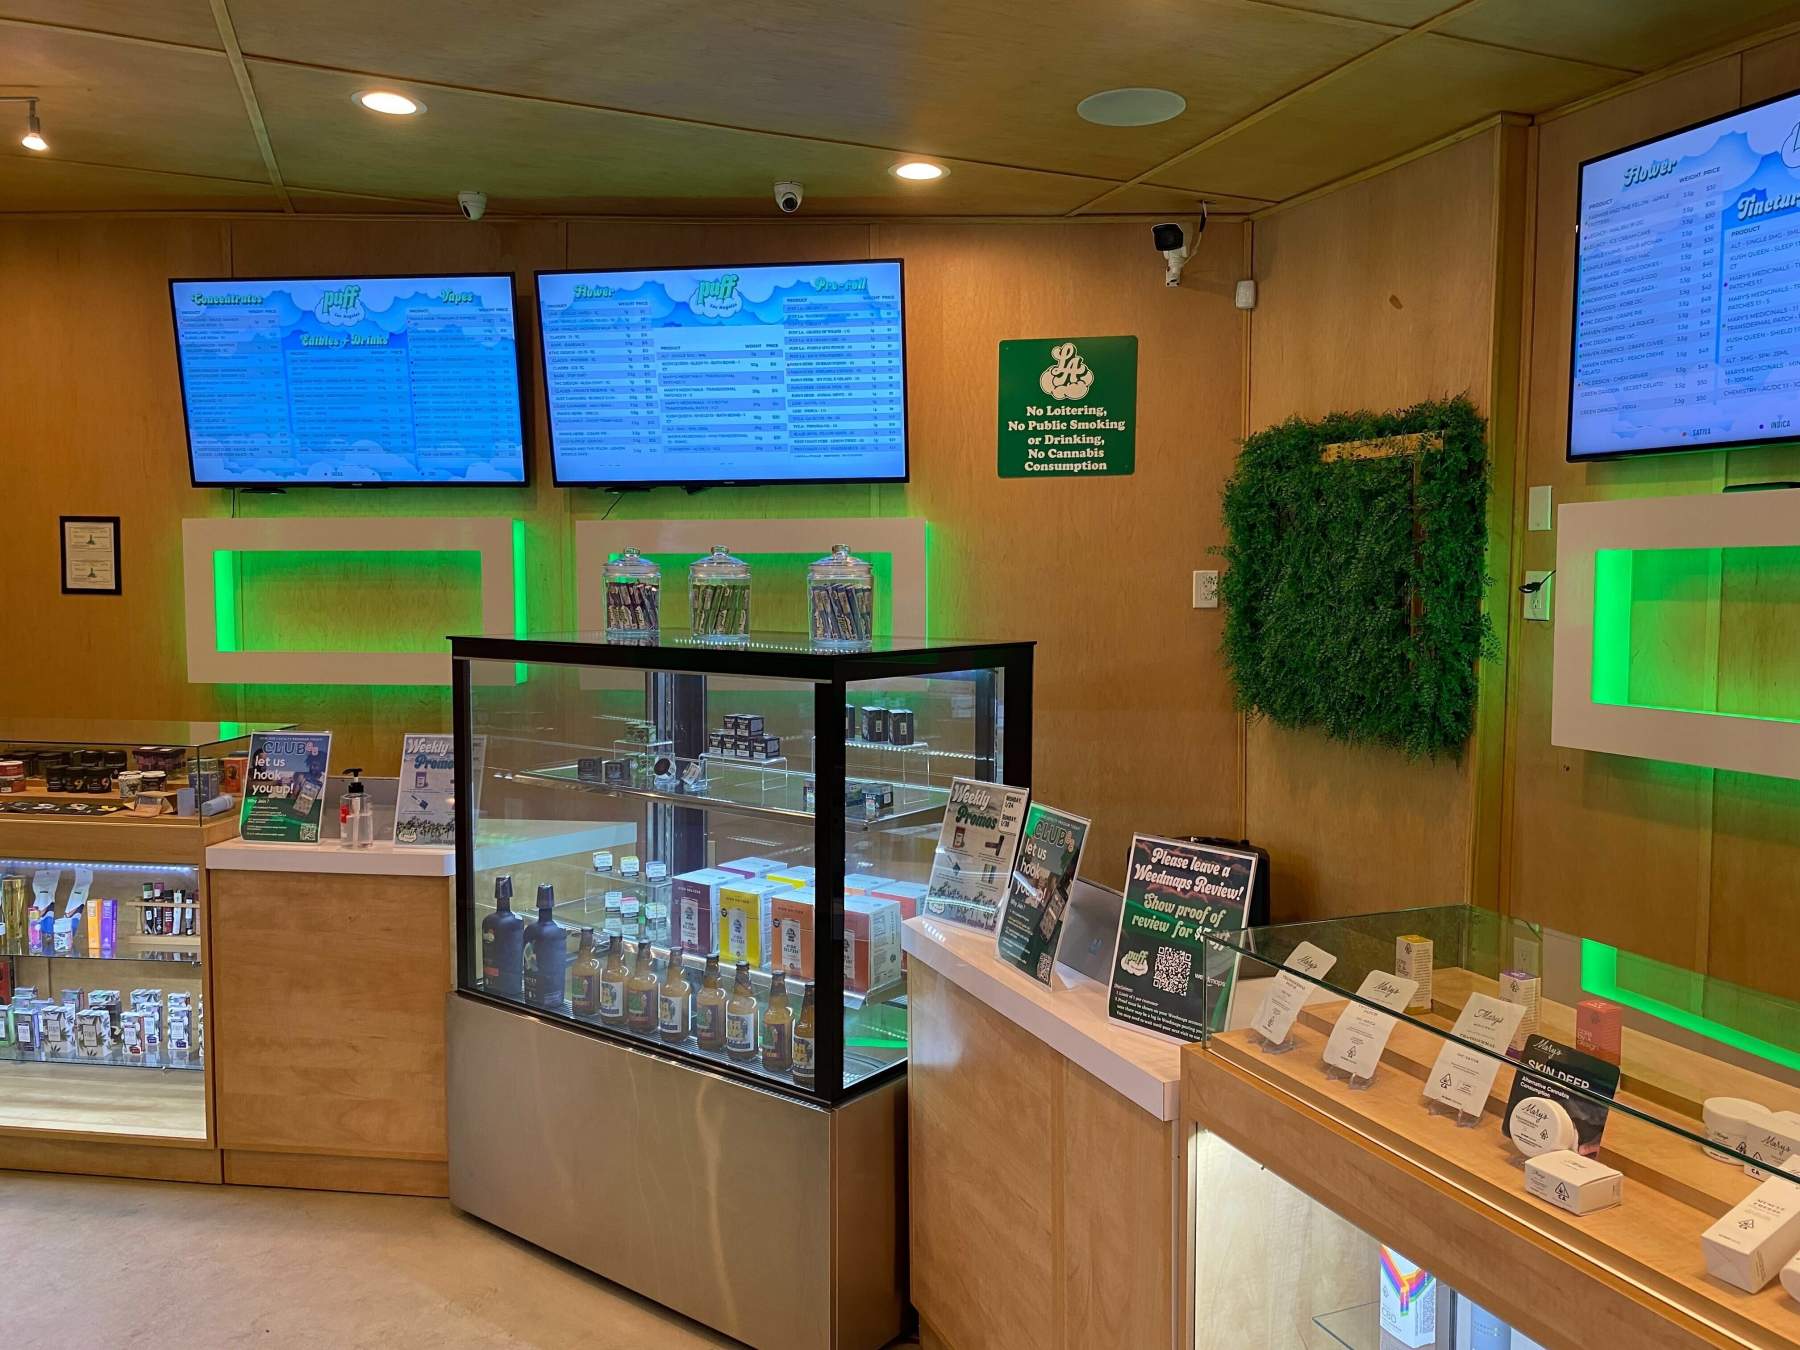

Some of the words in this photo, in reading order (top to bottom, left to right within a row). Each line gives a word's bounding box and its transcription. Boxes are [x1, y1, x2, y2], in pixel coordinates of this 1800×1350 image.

[1623, 158, 1677, 188] Flower
[1679, 172, 1701, 183] WEIGHT
[1703, 166, 1720, 176] PRICE
[1588, 198, 1614, 209] PRODUCT
[1738, 193, 1800, 221] Tinctur
[1731, 226, 1760, 236] PRODUCT
[697, 274, 739, 306] puff
[322, 285, 361, 314] puff
[1026, 406, 1043, 416] No
[1047, 406, 1107, 416] Loitering,
[1008, 422, 1025, 431] No
[1028, 420, 1066, 430] Public
[1070, 420, 1126, 431] Smoking
[1693, 428, 1711, 437] SATIVA
[1771, 421, 1790, 429] INDICA
[1028, 436, 1041, 444] or
[1045, 434, 1104, 446] Drinking,
[1028, 449, 1045, 458] No
[1048, 448, 1104, 458] Cannabis
[1025, 461, 1107, 472] Consumption
[263, 741, 306, 755] CLUB
[407, 738, 449, 756] Weekly
[256, 756, 271, 766] let
[414, 754, 454, 769] Promo
[254, 769, 281, 779] hook
[252, 785, 272, 795] you
[278, 783, 294, 794] up!
[952, 784, 990, 811] Weekly
[956, 806, 998, 830] Promos
[1034, 820, 1067, 848] CLUB
[1024, 839, 1037, 857] let
[1037, 848, 1047, 860] us
[1020, 857, 1040, 879] hook
[1151, 847, 1188, 868] Please
[1191, 857, 1220, 875] leave
[1222, 867, 1231, 877] a
[1134, 863, 1192, 891] Weedmaps
[1194, 876, 1244, 900] Review!
[1144, 893, 1175, 912] Show
[1175, 904, 1210, 923] proof
[1210, 909, 1226, 927] of
[1132, 914, 1170, 932] review
[1172, 920, 1193, 938] for
[1127, 950, 1148, 964] puff
[1528, 1059, 1555, 1076] SKIN
[1520, 1082, 1550, 1097] Consumption
[1522, 1076, 1546, 1090] Alternative
[1547, 1086, 1570, 1099] Cannabis
[1382, 1308, 1396, 1323] CBD
